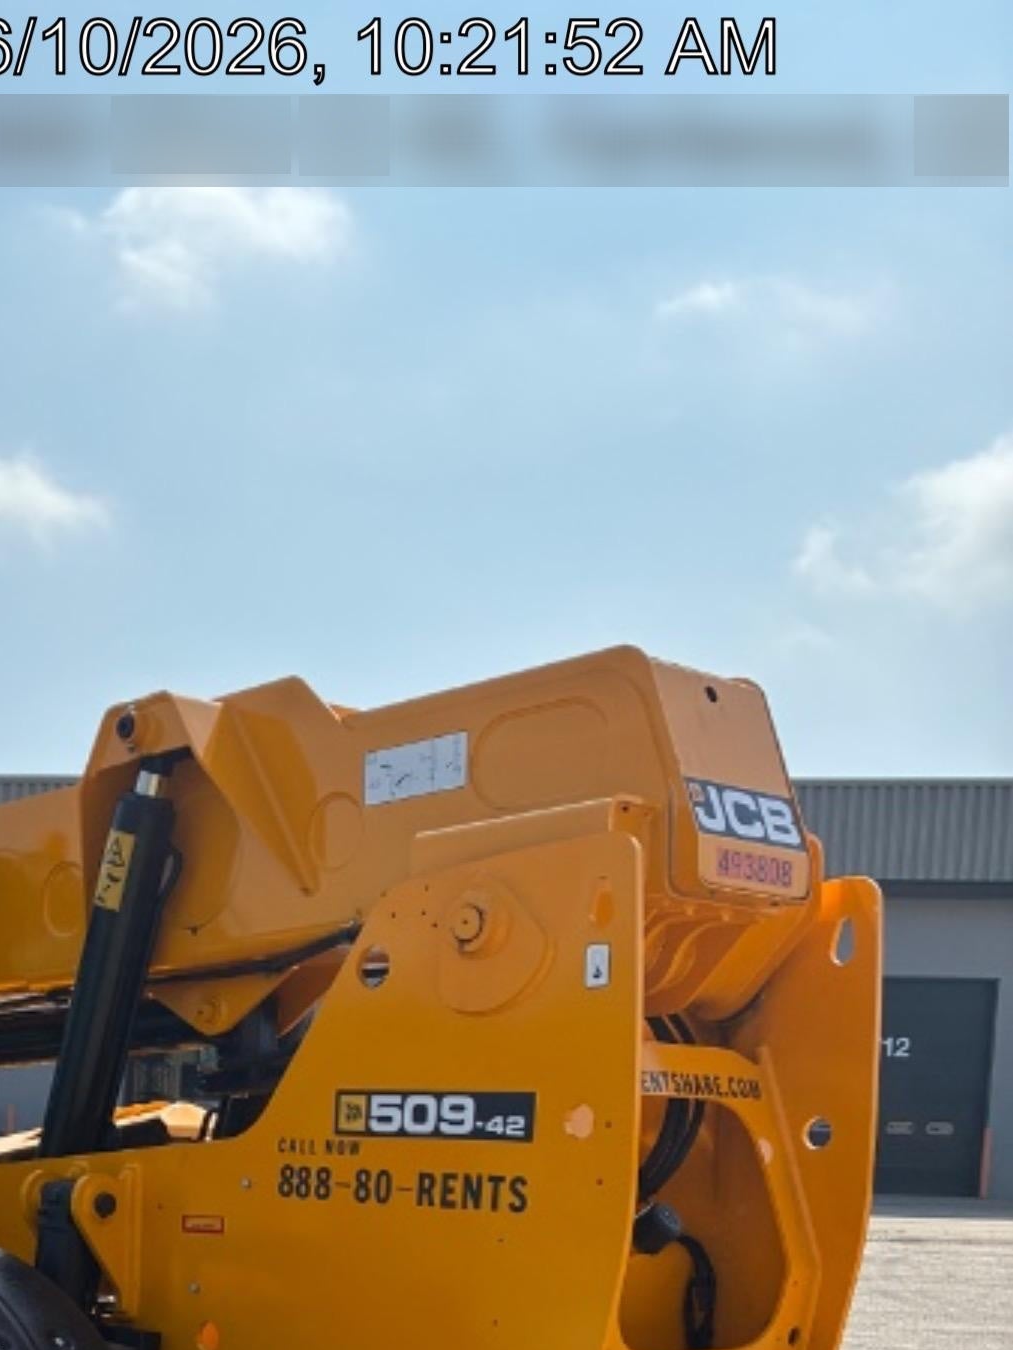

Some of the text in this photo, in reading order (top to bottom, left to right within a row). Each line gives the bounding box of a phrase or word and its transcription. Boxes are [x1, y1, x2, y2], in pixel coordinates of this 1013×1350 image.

[694, 784, 802, 846] JCB
[882, 1036, 911, 1058] 12
[640, 1070, 763, 1100] ENTSHARE.COM
[367, 1094, 527, 1137] 509-42
[277, 1137, 362, 1157] CALL NOW
[277, 1163, 529, 1214] 888-80-RENTS
